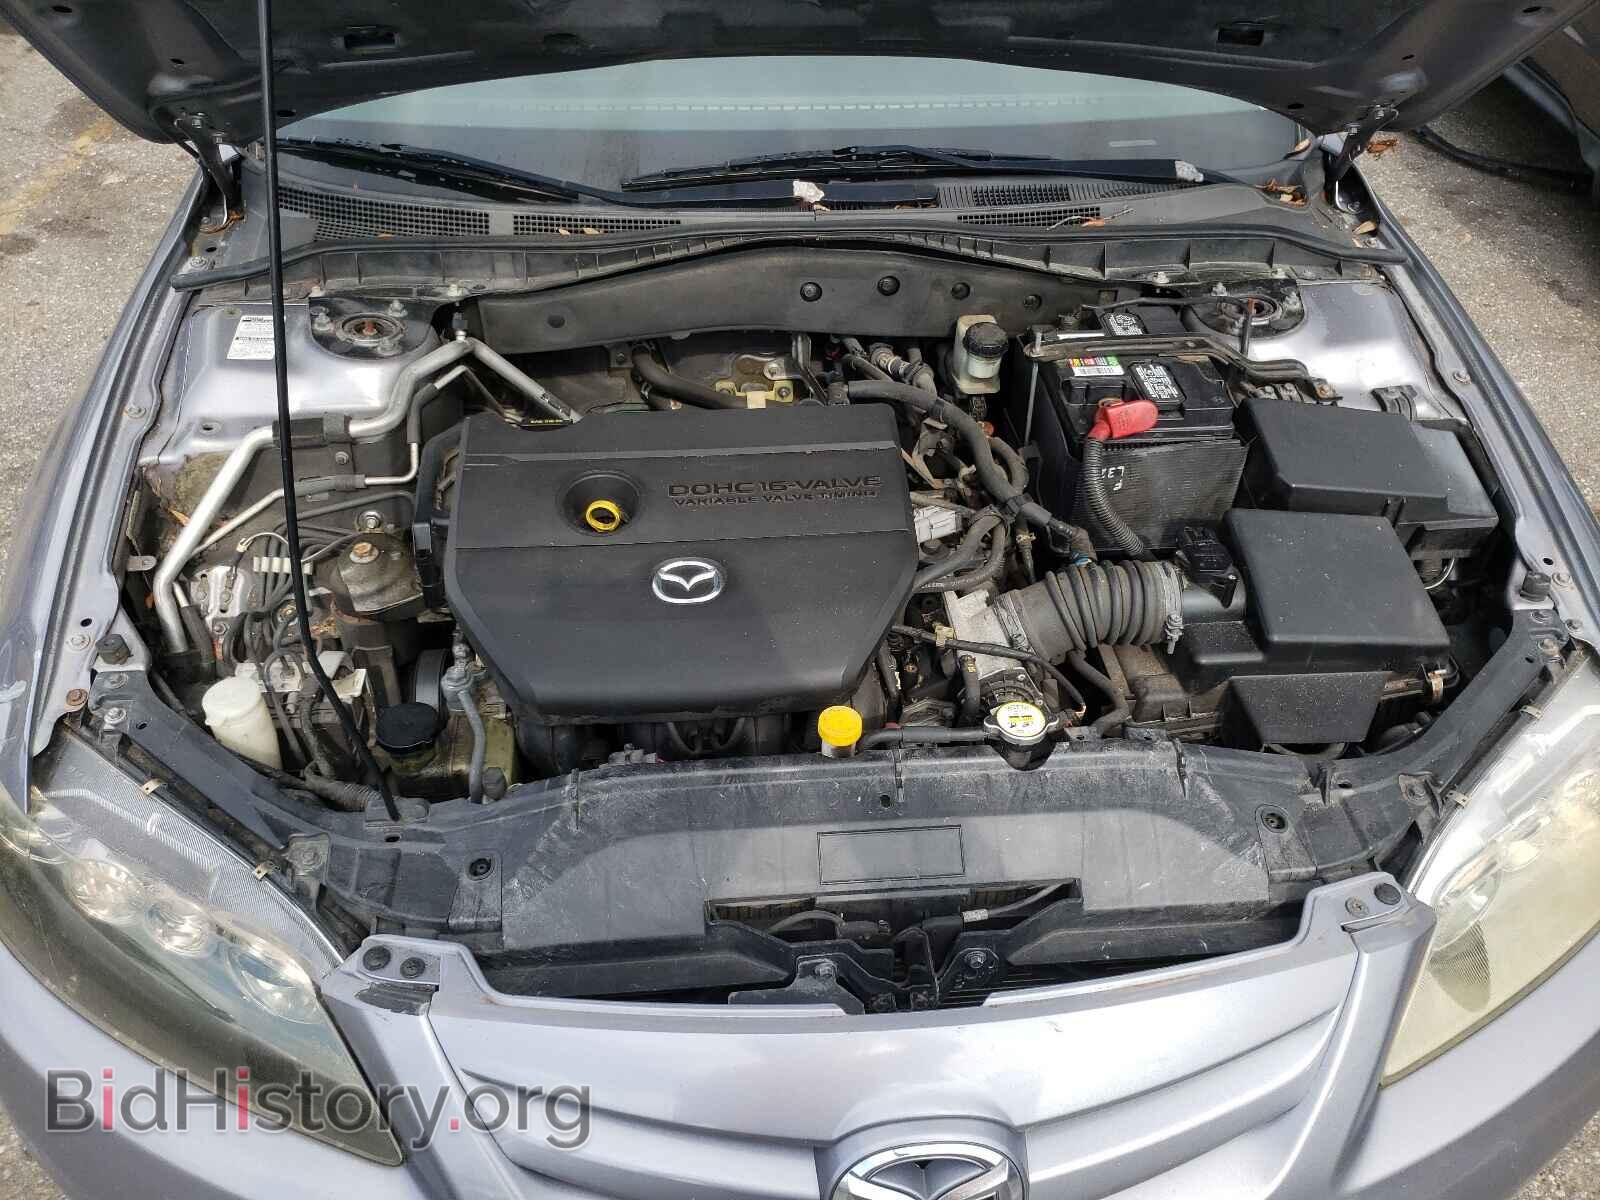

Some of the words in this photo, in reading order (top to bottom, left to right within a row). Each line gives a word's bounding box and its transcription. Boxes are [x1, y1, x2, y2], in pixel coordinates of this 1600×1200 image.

[667, 481, 754, 496] DOHC
[759, 474, 881, 493] 16-VALVE
[673, 495, 756, 507] VARIABLE
[762, 493, 814, 504] VALVE
[820, 489, 877, 500] TIMING
